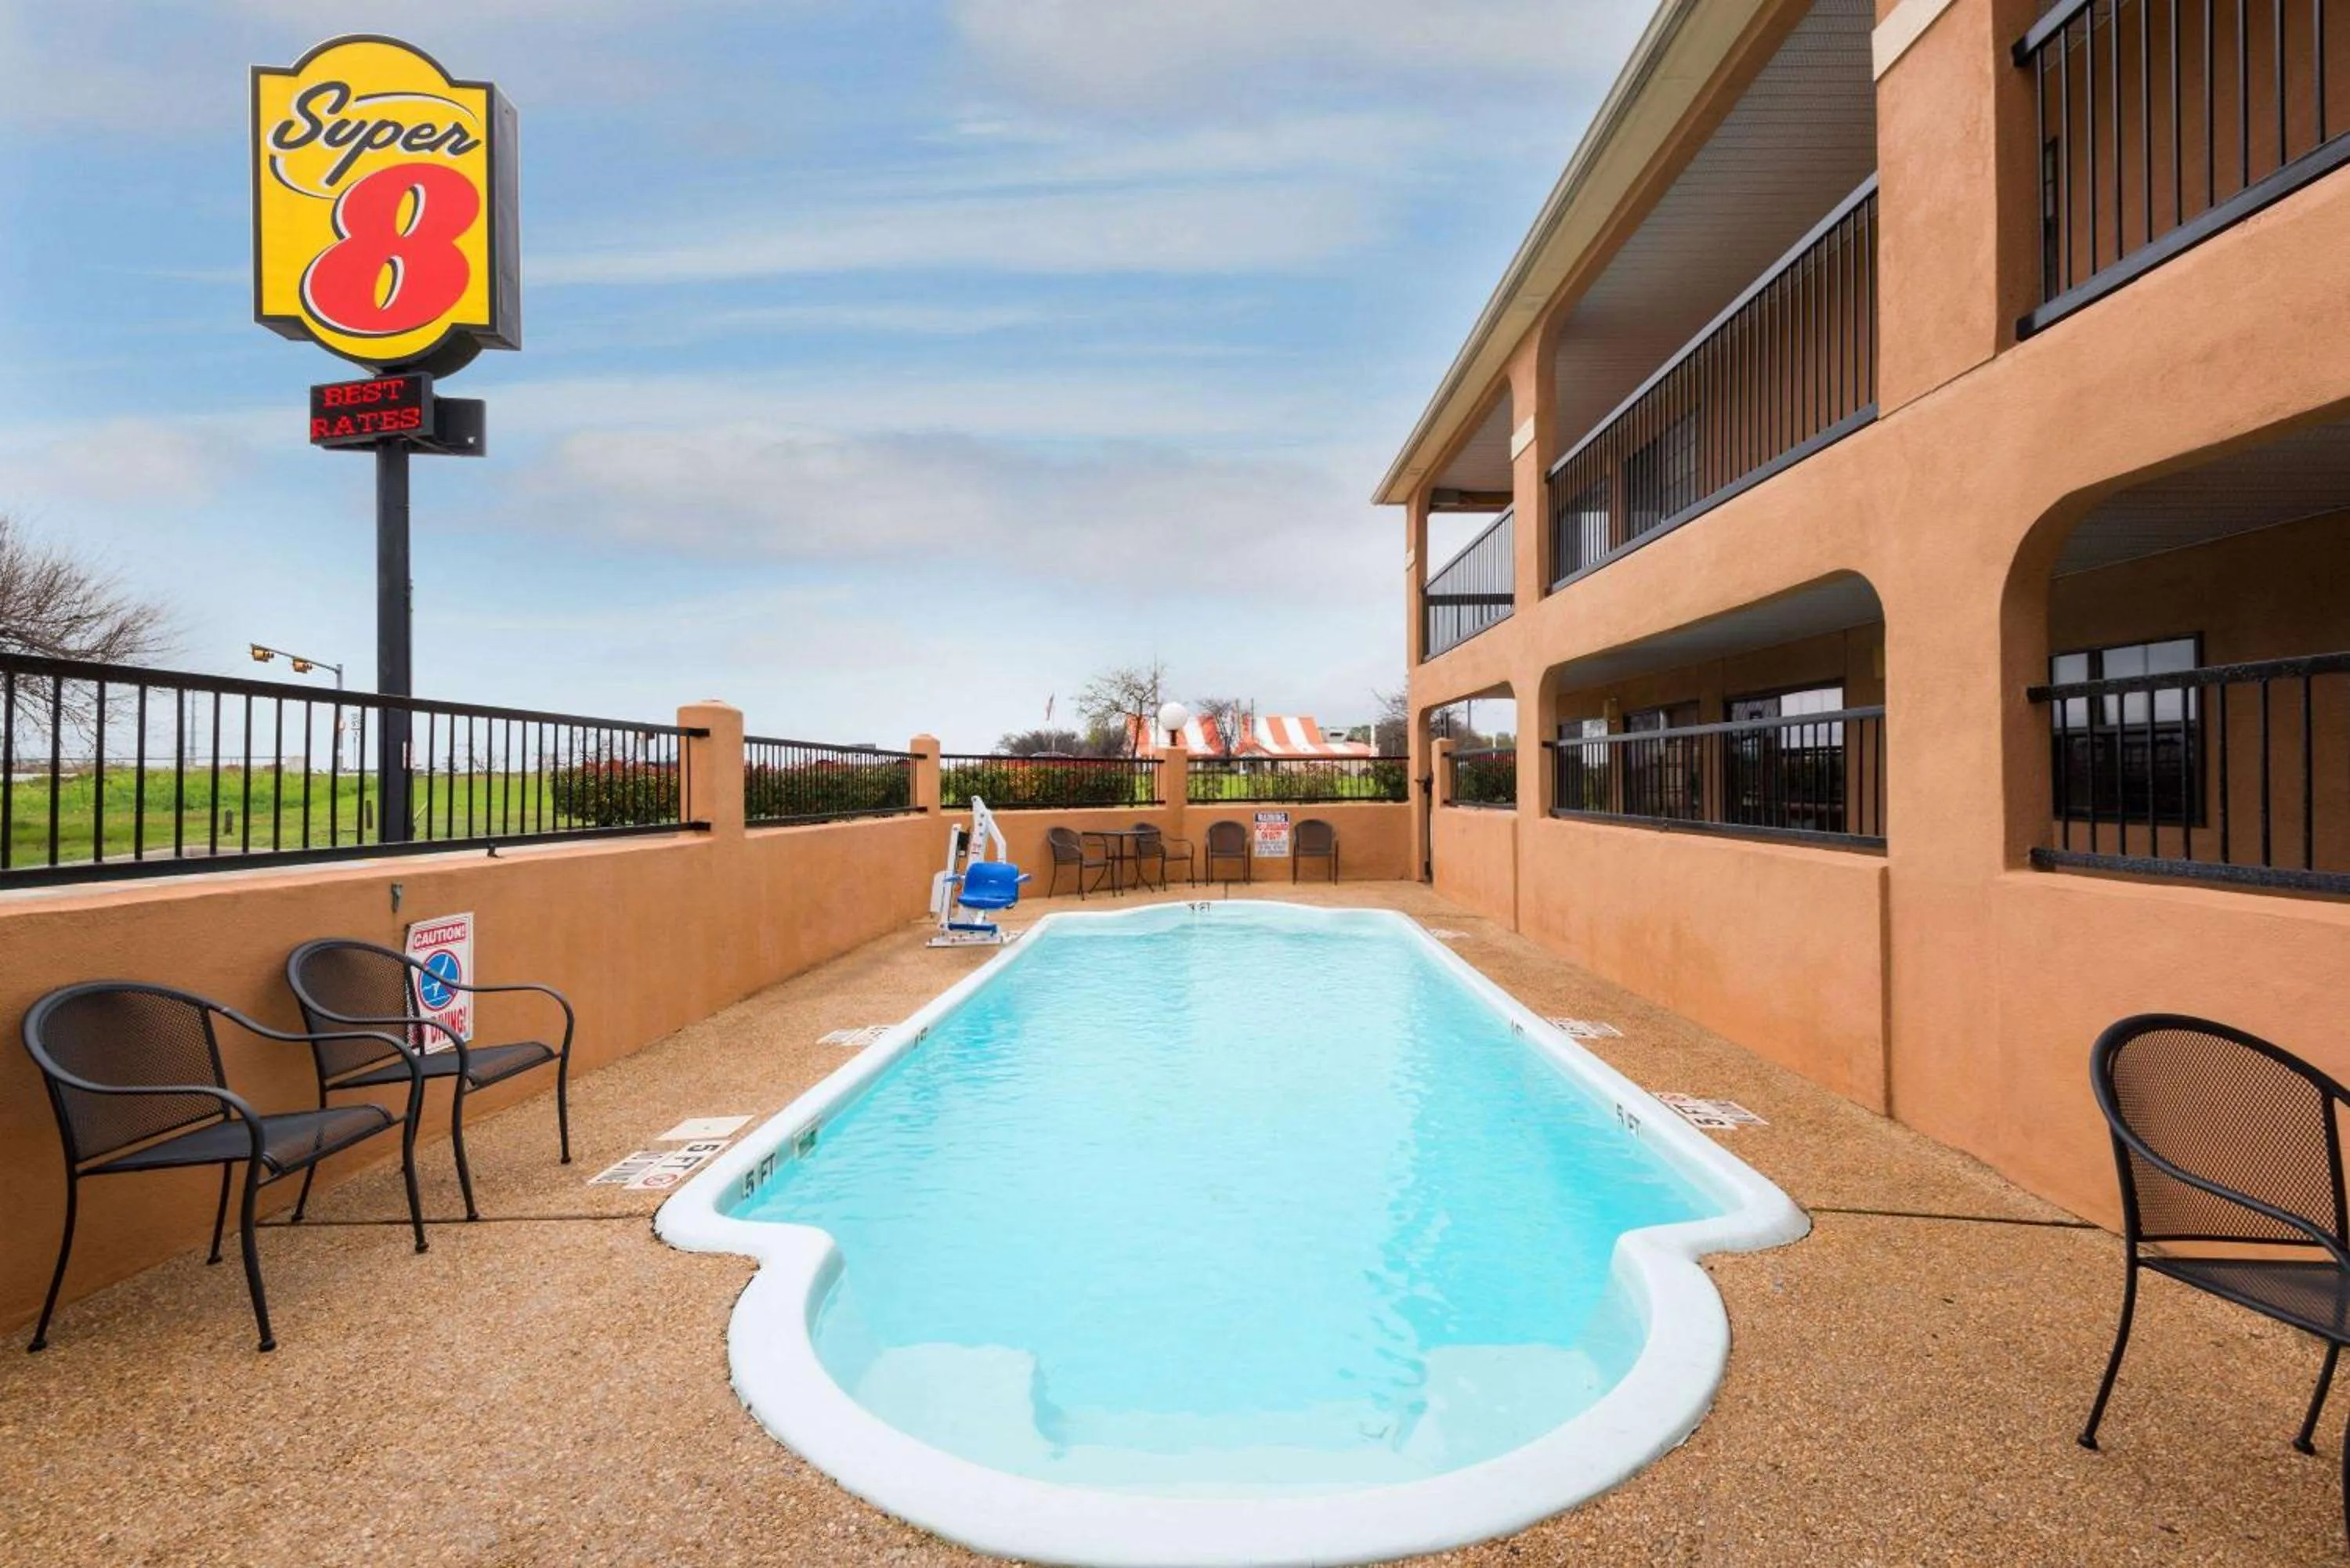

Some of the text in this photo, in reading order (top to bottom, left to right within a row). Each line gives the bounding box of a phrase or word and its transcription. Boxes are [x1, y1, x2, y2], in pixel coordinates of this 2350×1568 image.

[269, 81, 480, 187] Super
[299, 162, 480, 338] 8
[323, 379, 404, 407] BEST
[311, 406, 421, 440] RATES
[414, 923, 466, 948] CAUTION!
[661, 1156, 703, 1169] FT
[761, 1153, 776, 1185] FT
